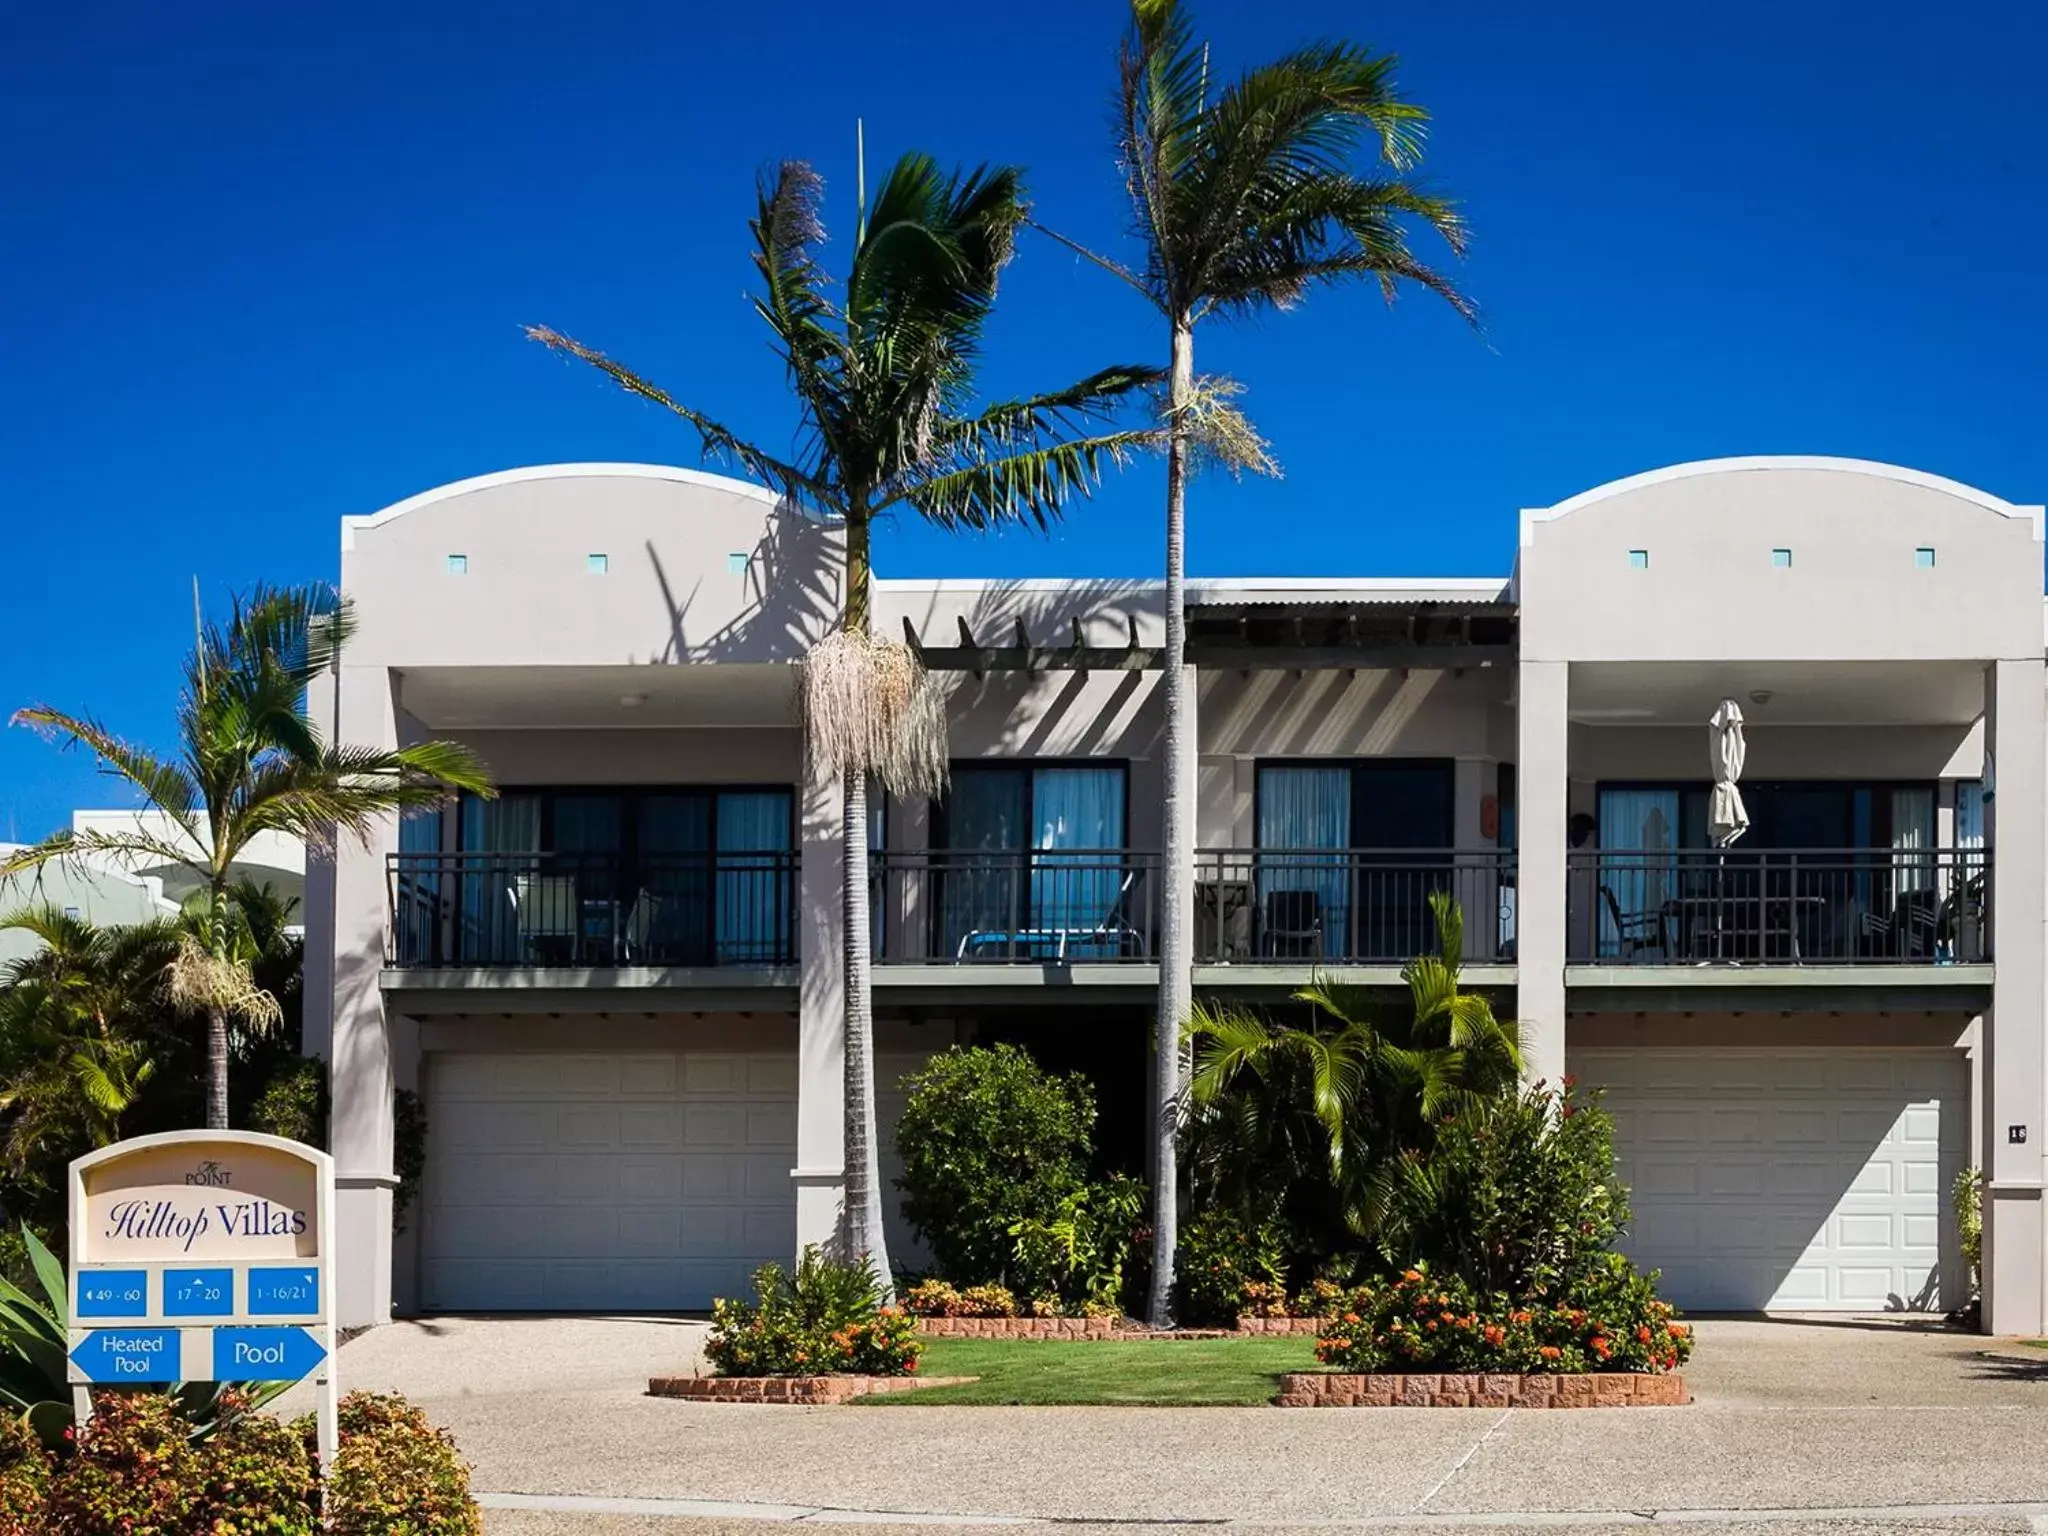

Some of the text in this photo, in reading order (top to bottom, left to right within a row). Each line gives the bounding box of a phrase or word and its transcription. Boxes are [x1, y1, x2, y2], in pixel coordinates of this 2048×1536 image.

[185, 1172, 232, 1185] POINT
[105, 1200, 306, 1252] Hilltop Villas
[95, 1289, 113, 1301] 49
[123, 1289, 141, 1301] 60
[177, 1288, 192, 1300] 17
[204, 1288, 221, 1300] 20
[102, 1336, 163, 1352] Heated
[235, 1342, 284, 1363] Pool
[115, 1356, 150, 1373] Pool
